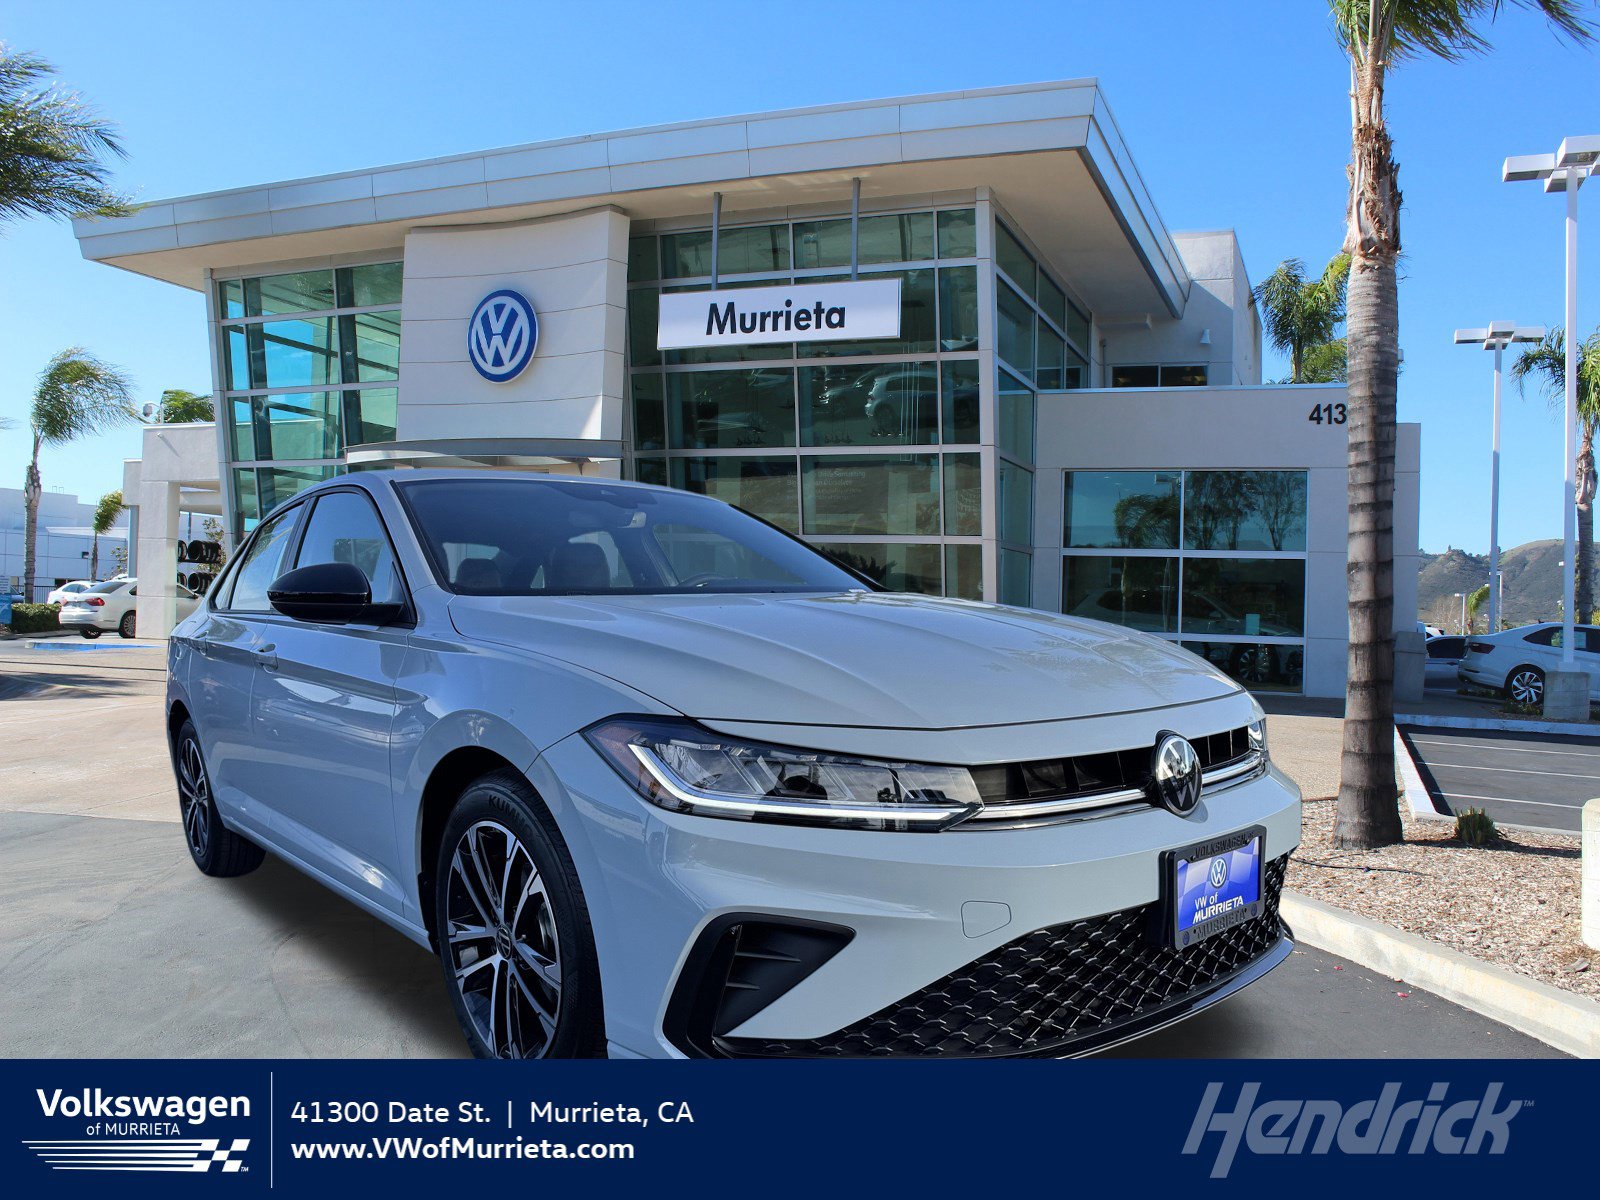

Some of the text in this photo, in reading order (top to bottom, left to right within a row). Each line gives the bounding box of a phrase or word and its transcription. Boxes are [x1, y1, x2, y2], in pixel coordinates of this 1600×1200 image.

[706, 299, 846, 335] Murrieta
[1309, 403, 1347, 425] 413
[1195, 833, 1247, 858] VOLKSWAGEN
[1192, 895, 1244, 925] MURRIETA
[1194, 891, 1219, 911] VW of
